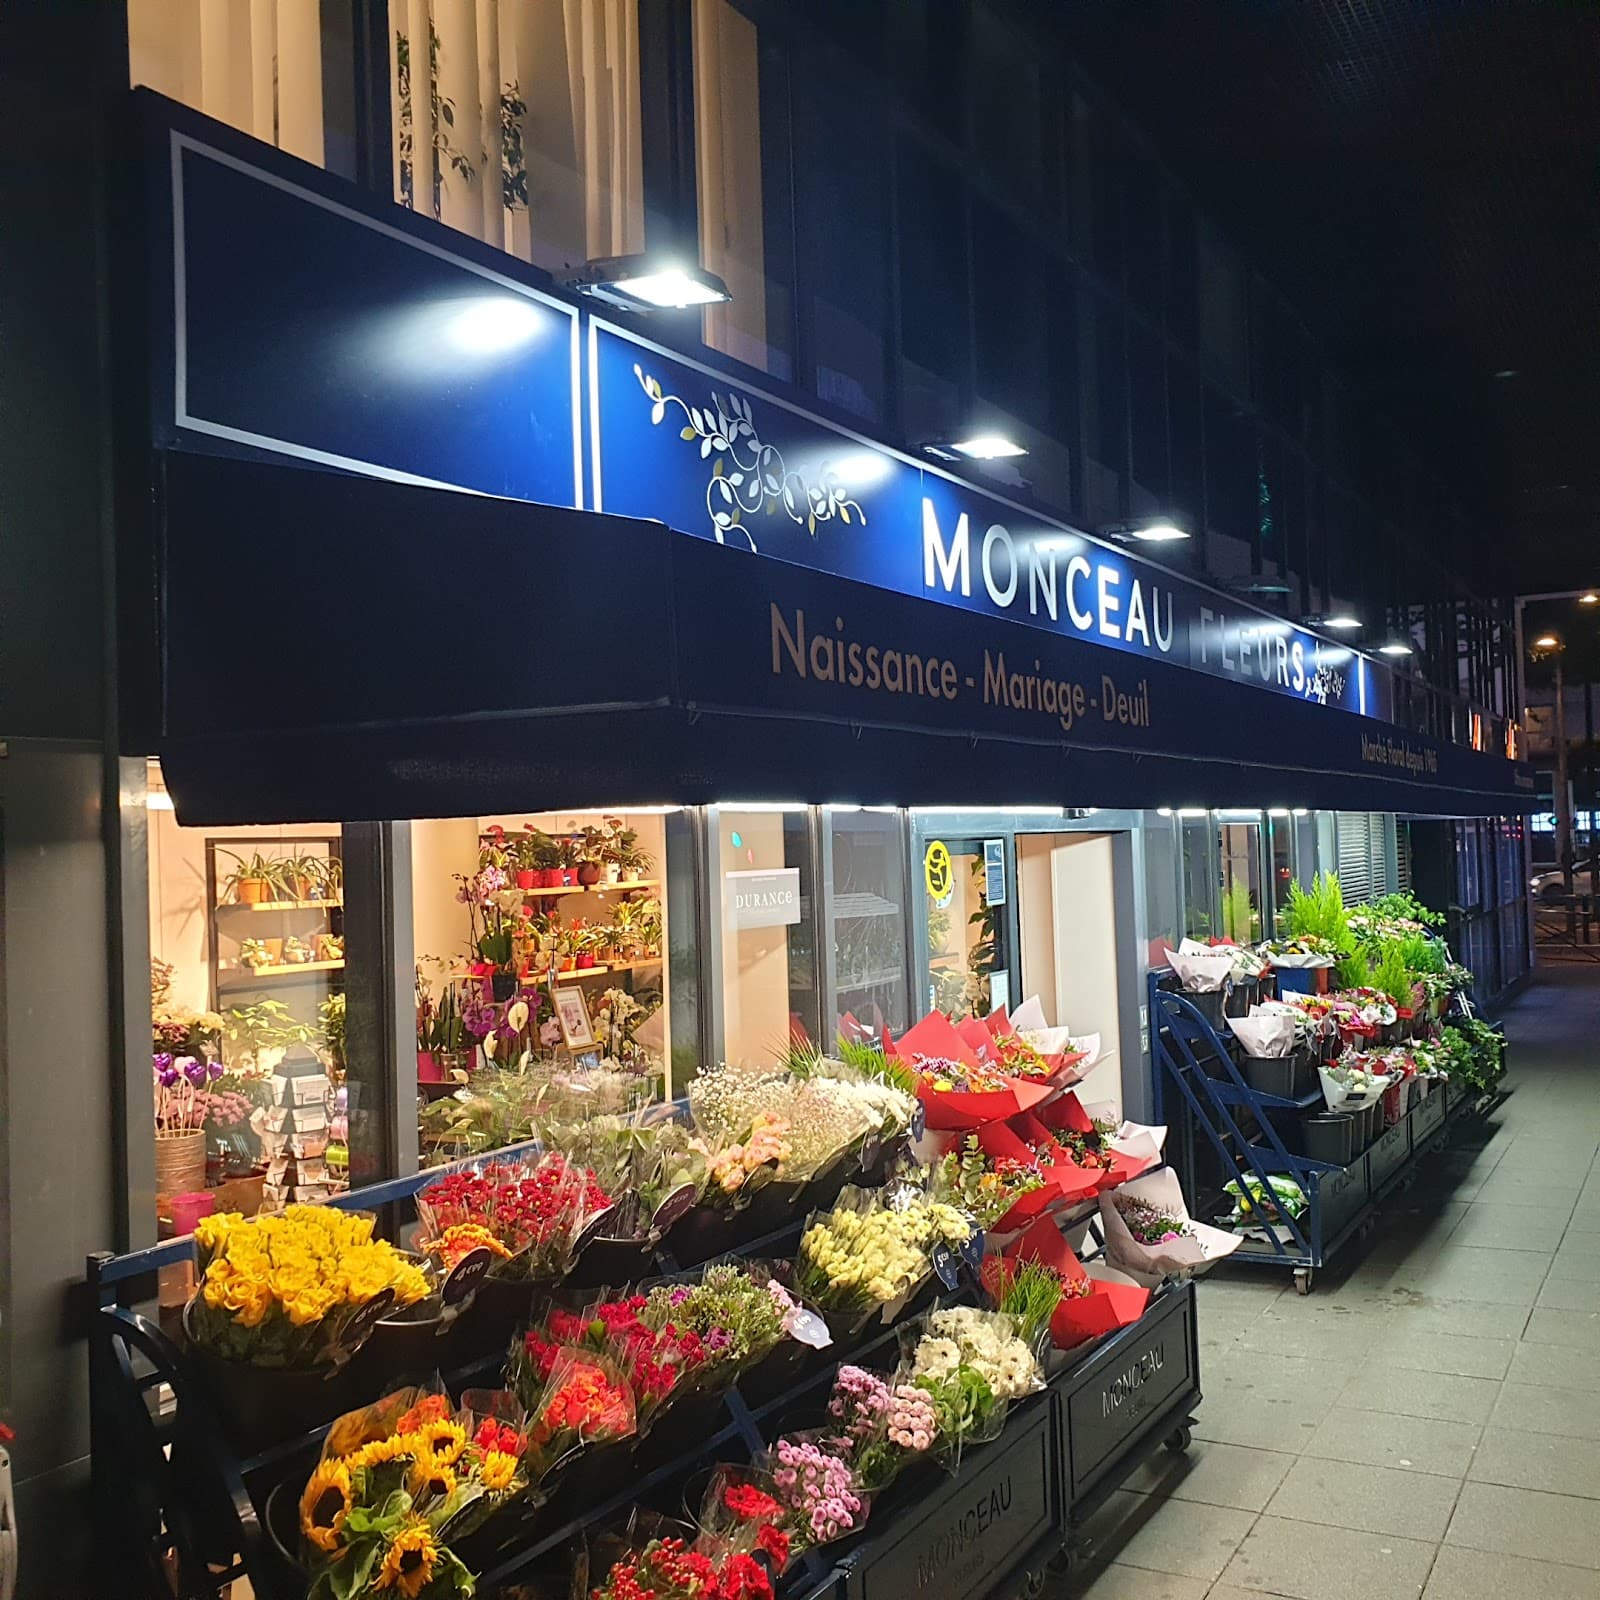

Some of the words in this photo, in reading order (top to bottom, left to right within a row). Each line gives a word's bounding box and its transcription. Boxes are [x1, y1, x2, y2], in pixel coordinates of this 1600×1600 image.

[922, 497, 1174, 652] MONCEAU
[1200, 606, 1304, 692] FLEURS
[770, 602, 957, 700] Naissance
[983, 649, 1086, 730] Mariage
[1102, 674, 1150, 728] Deuil
[1101, 1341, 1164, 1418] MONCEAU
[917, 1475, 1013, 1589] MONCEAU
